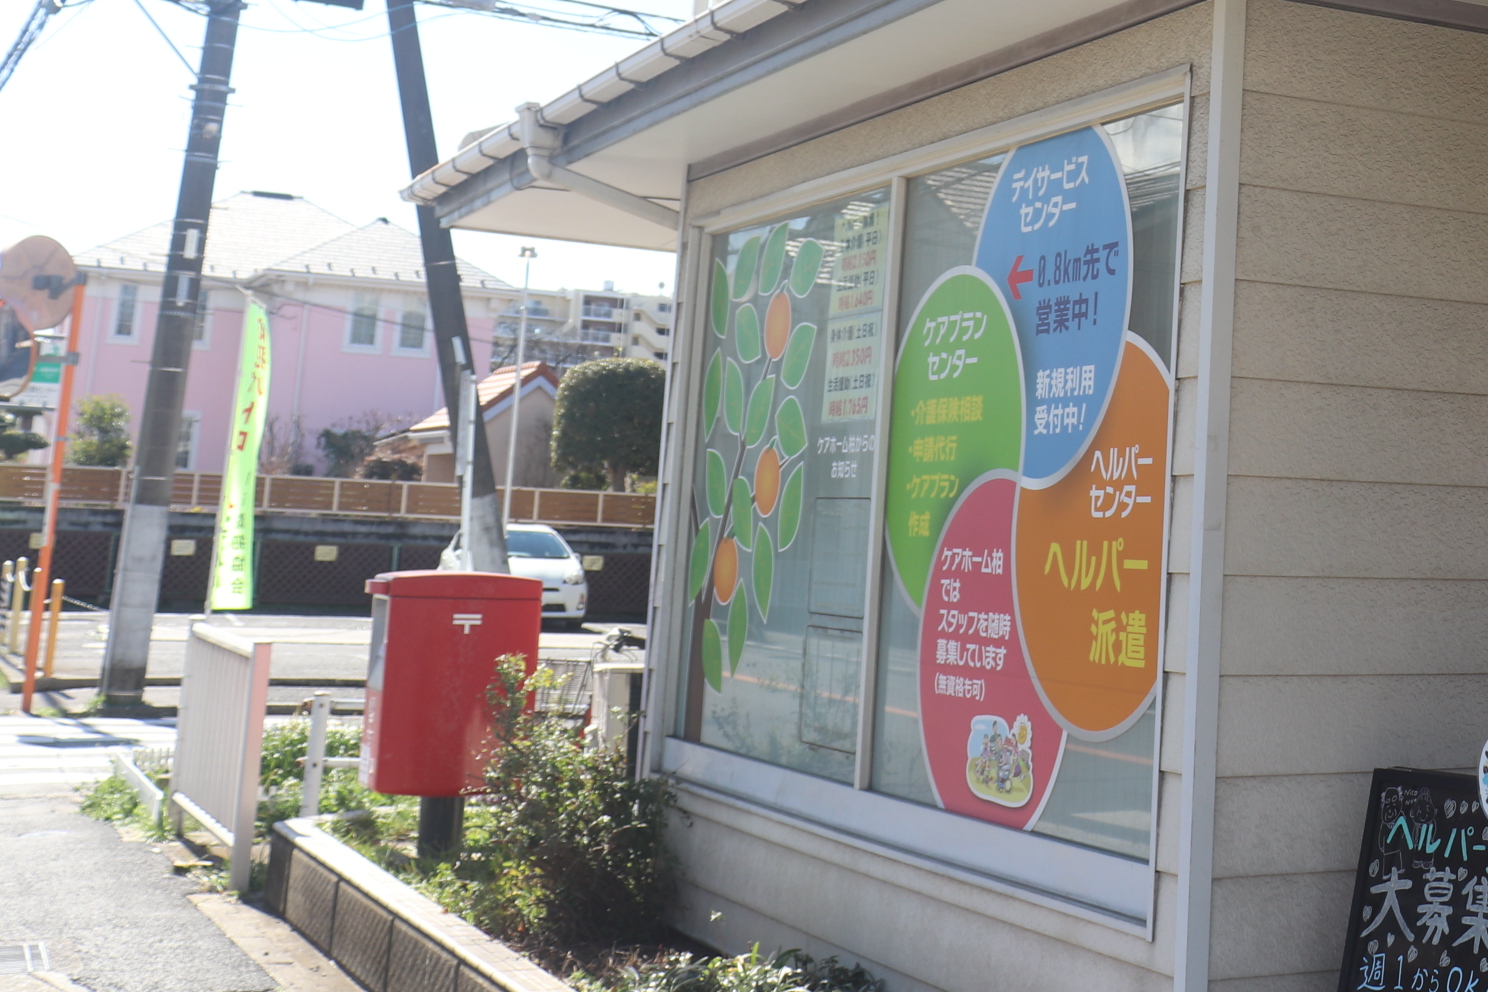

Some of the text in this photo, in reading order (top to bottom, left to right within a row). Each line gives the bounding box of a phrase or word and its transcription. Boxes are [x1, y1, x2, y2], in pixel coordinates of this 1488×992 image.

[1011, 154, 1089, 203] デイサービス
[1019, 195, 1077, 233] センター
[1037, 241, 1119, 288] 0.8km先で
[922, 310, 987, 347] ケアプラン
[927, 349, 978, 381] センター
[1035, 364, 1095, 400] 新規利用
[830, 460, 857, 479] お知らせ
[1090, 444, 1153, 481] ヘルパー
[1089, 484, 1152, 518] センター
[908, 511, 931, 537] 作成
[941, 547, 1004, 575] ケアホーム柏
[1044, 537, 1149, 592] ヘルパー
[940, 578, 961, 602] では
[937, 609, 1011, 640] スタッフを随時
[1088, 608, 1147, 668] 派遣
[935, 638, 1006, 671] 募集しています
